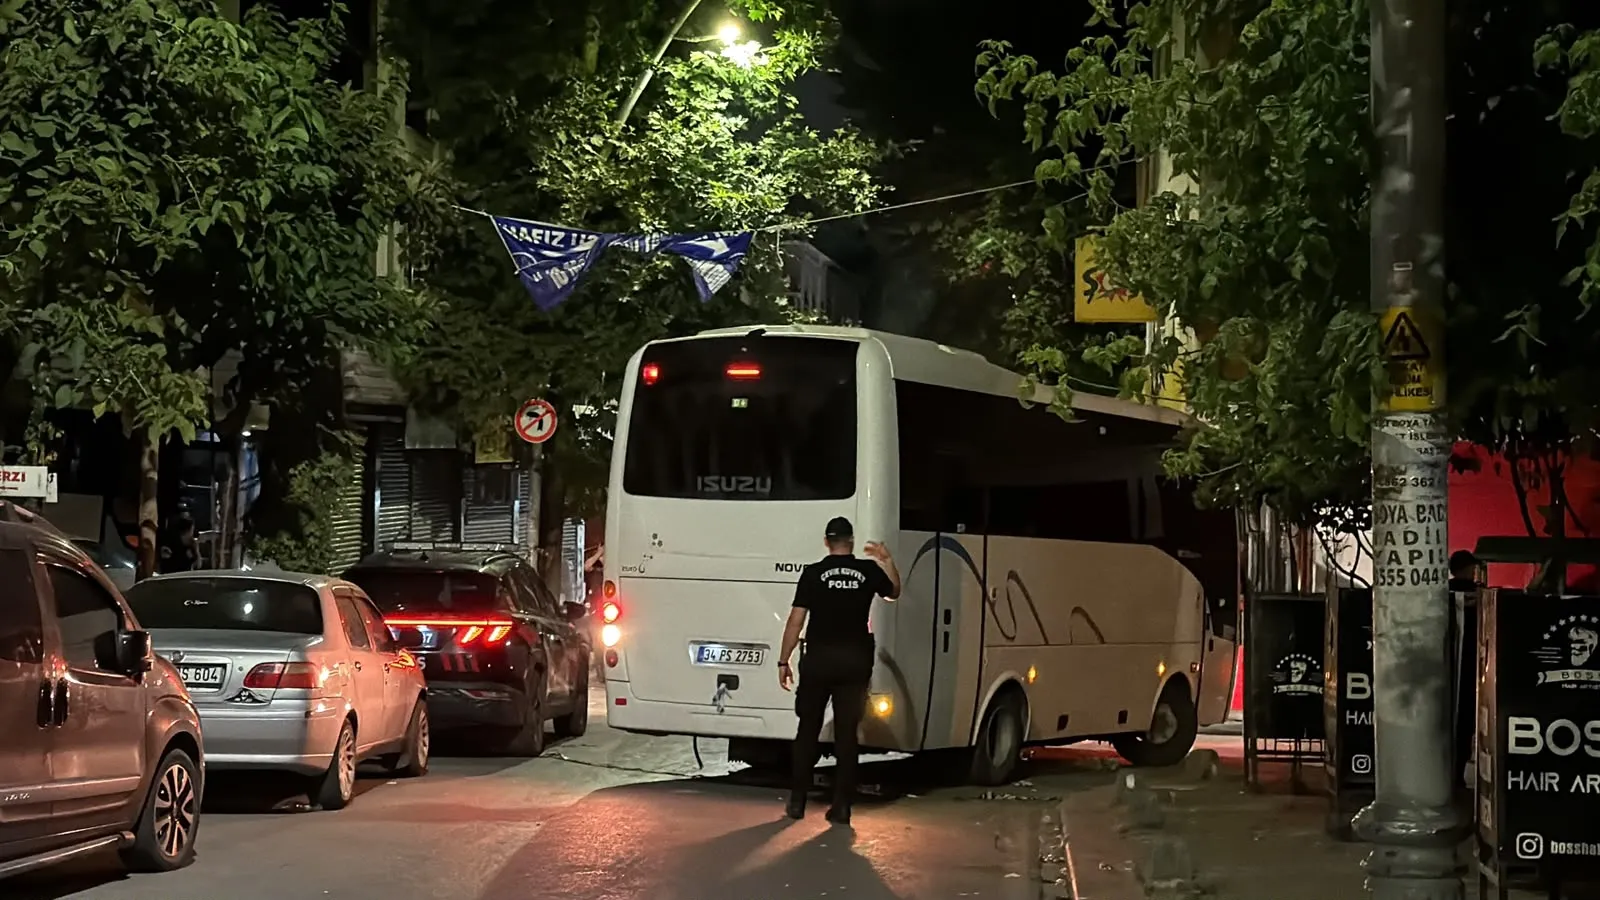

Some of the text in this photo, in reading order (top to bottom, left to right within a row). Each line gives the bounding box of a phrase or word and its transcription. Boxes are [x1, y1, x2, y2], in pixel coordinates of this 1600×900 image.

[0, 471, 26, 482] RZI
[697, 476, 772, 492] ISUZU
[775, 563, 806, 573] NOV
[704, 649, 760, 663] 34 PS 2753
[194, 667, 218, 682] 604
[1508, 770, 1559, 792] HAIR
